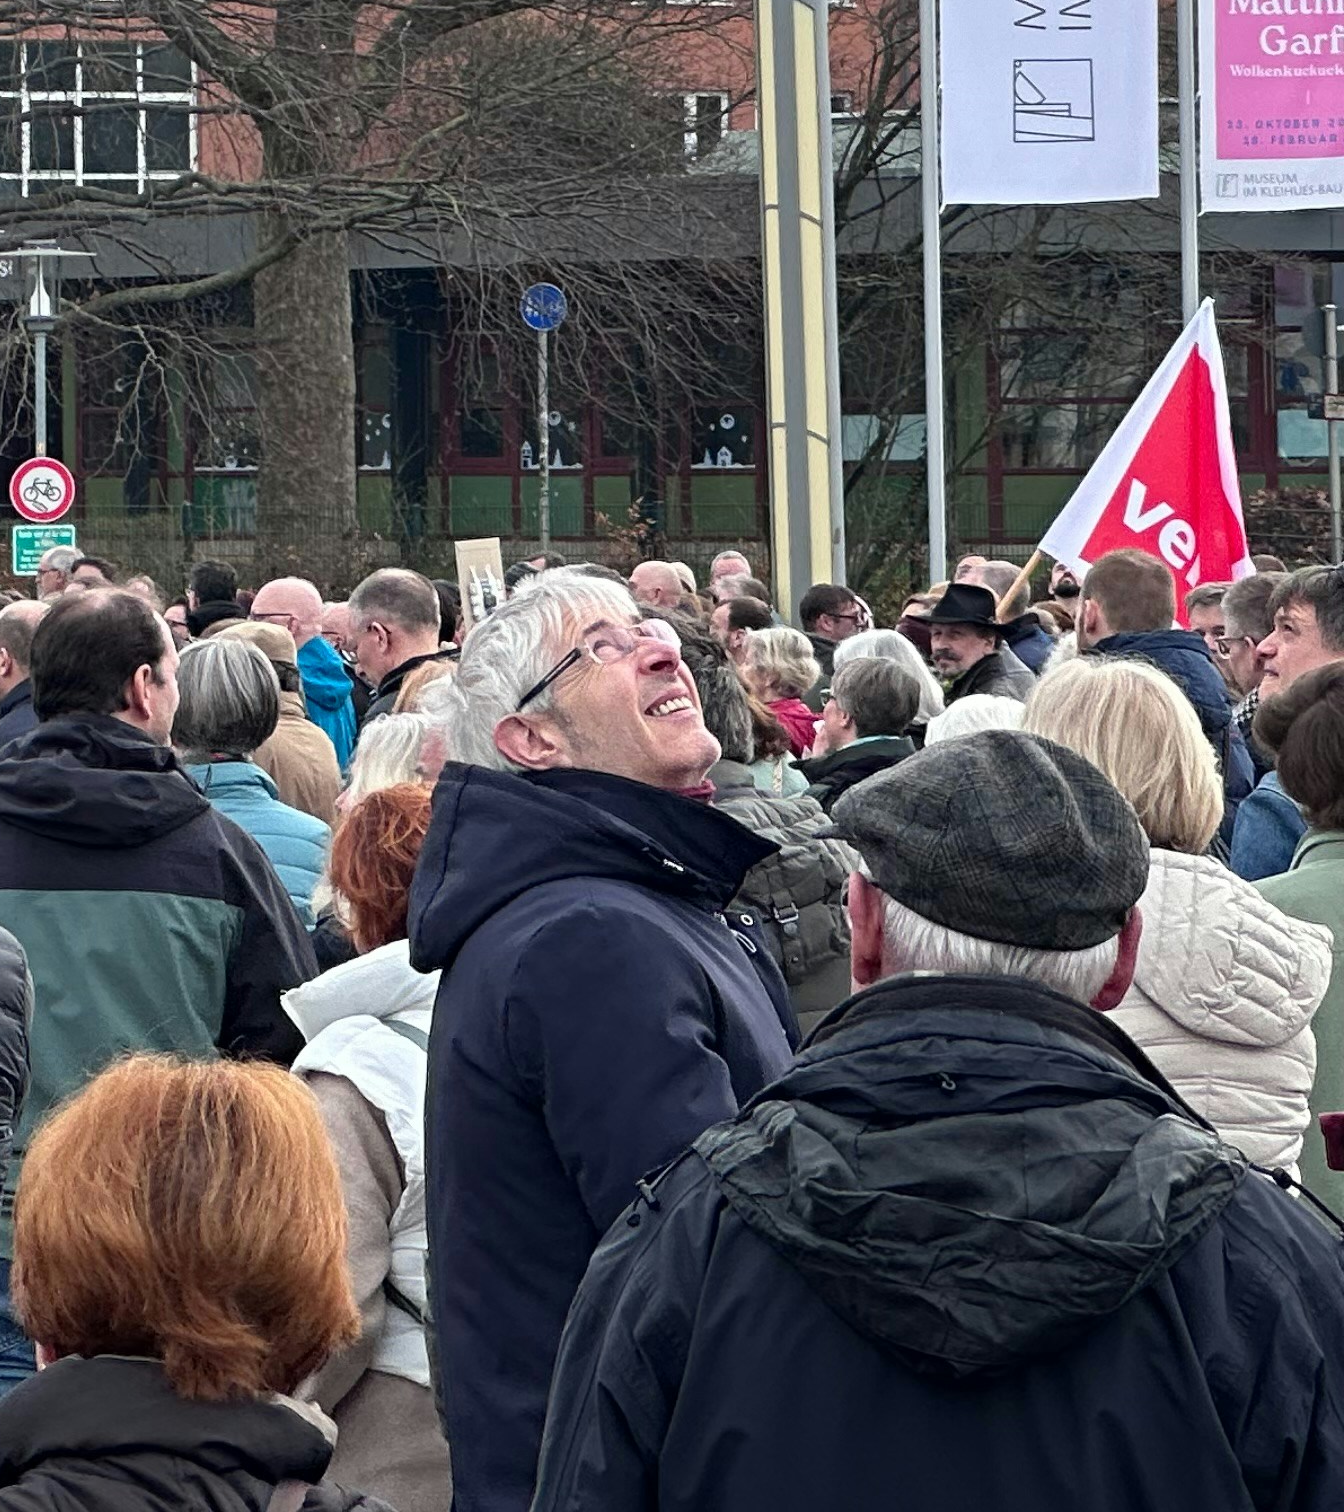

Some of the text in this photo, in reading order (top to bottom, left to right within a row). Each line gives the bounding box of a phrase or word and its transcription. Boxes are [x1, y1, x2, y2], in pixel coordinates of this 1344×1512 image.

[1255, 118, 1320, 129] OKTOBER
[1271, 133, 1338, 145] FEBRUAR
[1243, 173, 1299, 184] MUSEUM
